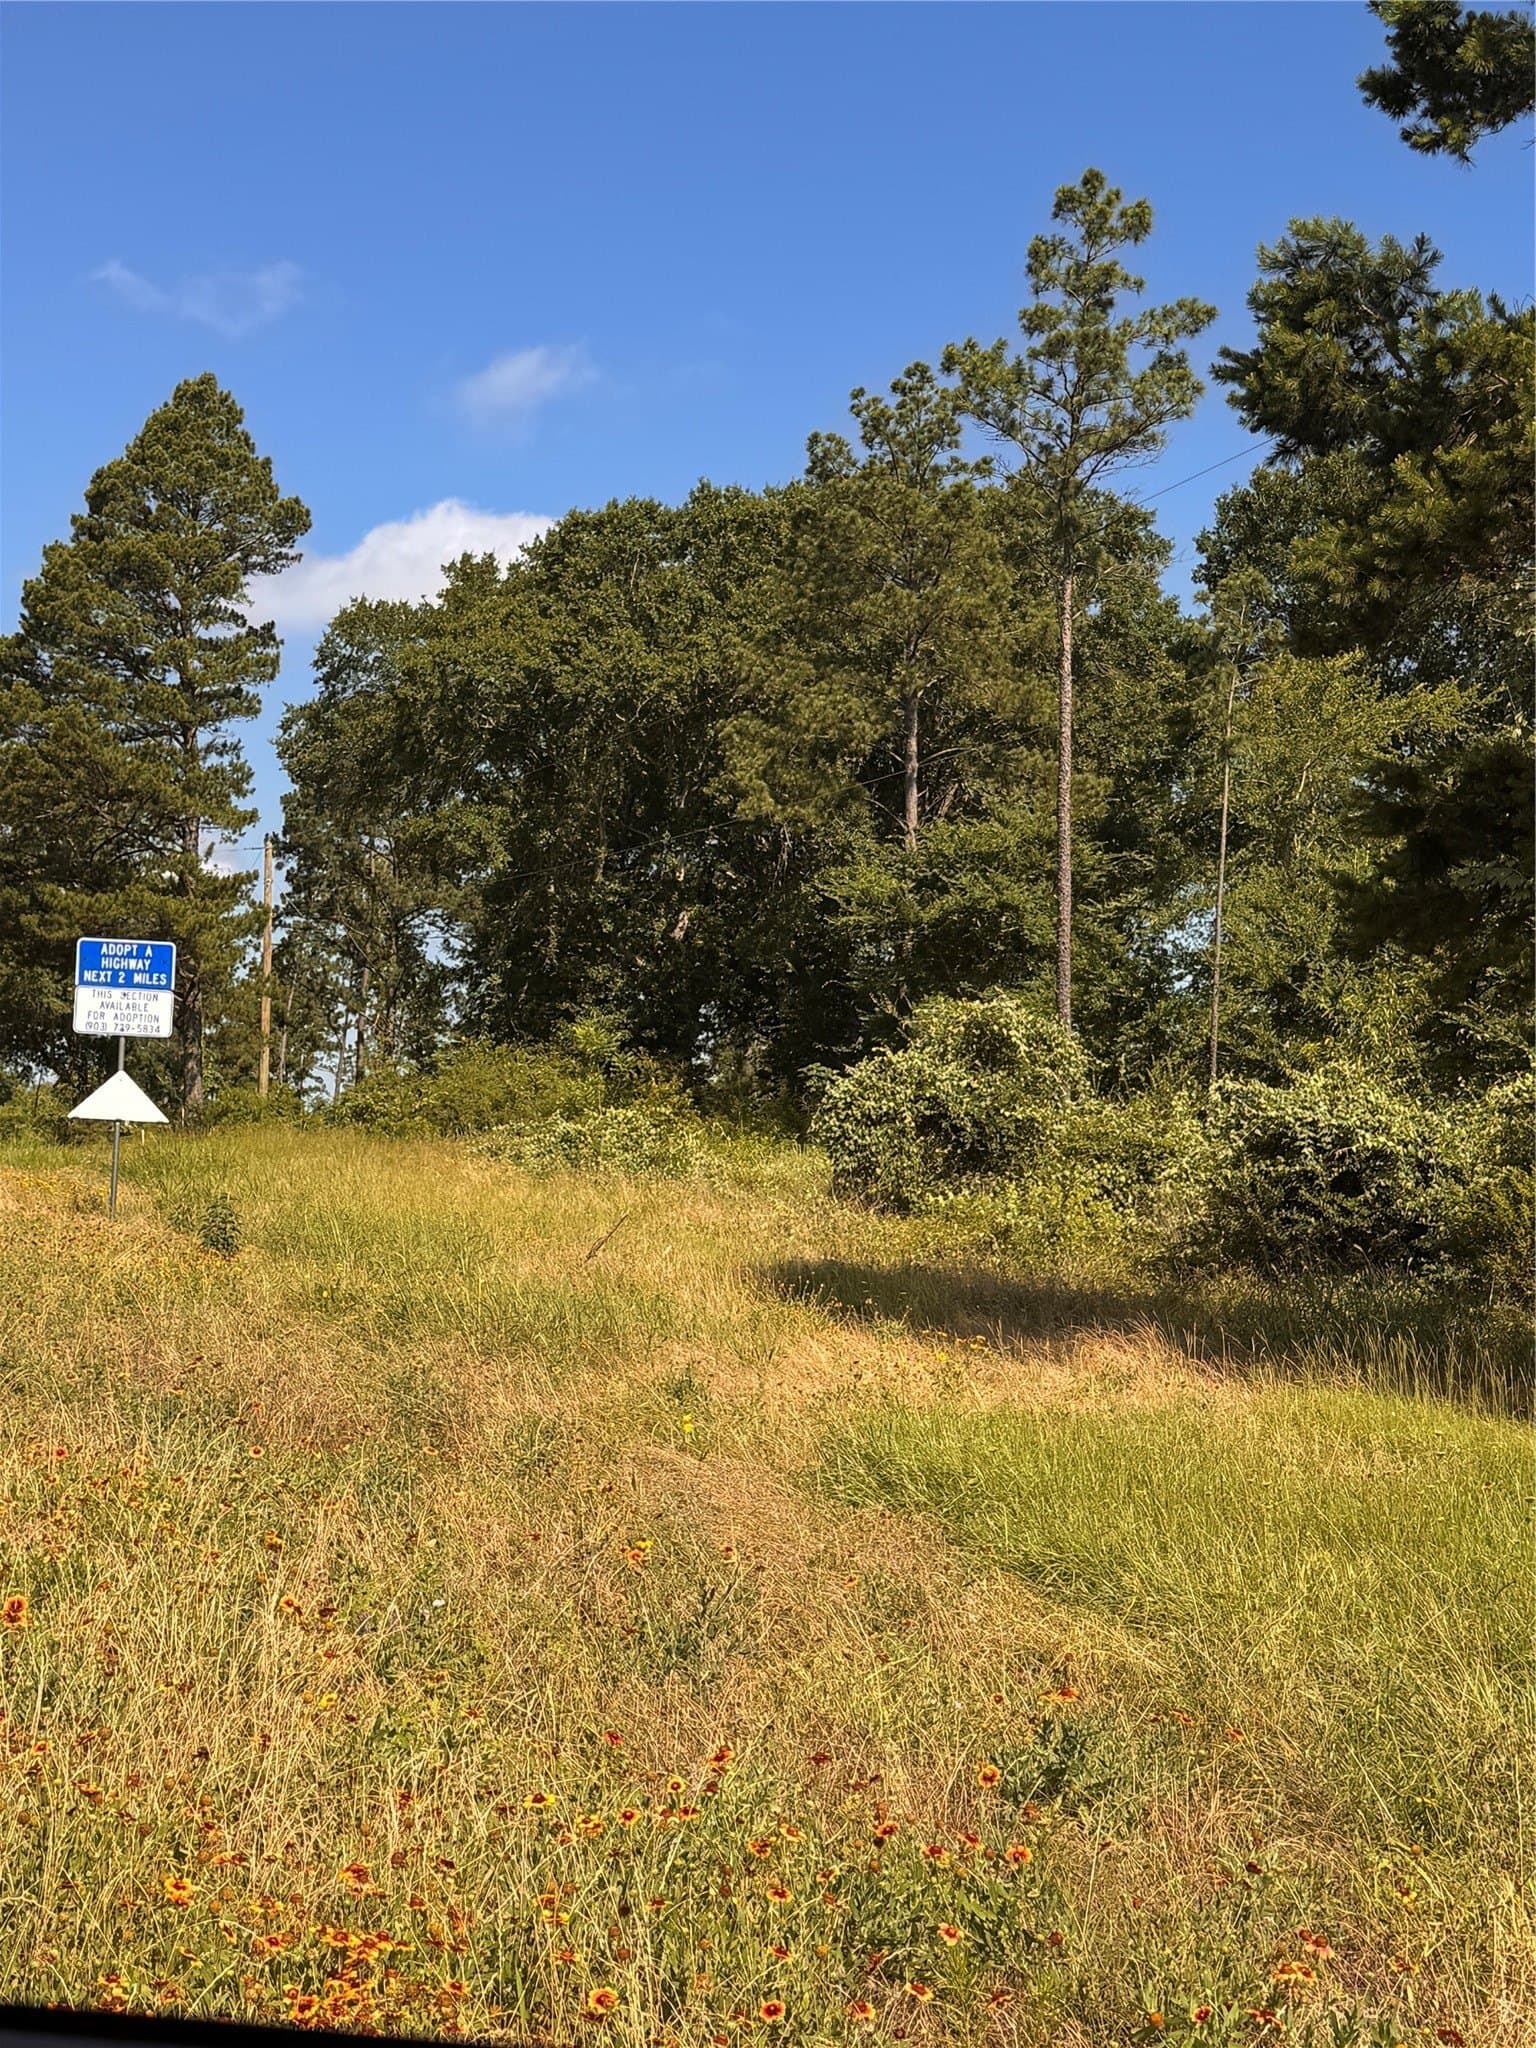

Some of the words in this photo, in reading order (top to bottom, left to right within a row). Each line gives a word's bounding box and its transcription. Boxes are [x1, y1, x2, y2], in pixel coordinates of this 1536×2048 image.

[101, 944, 138, 956] ADOPT
[145, 945, 152, 958] A
[101, 957, 151, 970] HIGHWAY
[84, 970, 112, 982] NEXT
[118, 972, 126, 984] 2
[134, 973, 167, 985] MILES
[92, 989, 112, 998] THIS
[100, 1001, 149, 1012] AVAILABLE
[88, 1010, 105, 1020] FOR
[114, 1012, 160, 1023] ADOPTION
